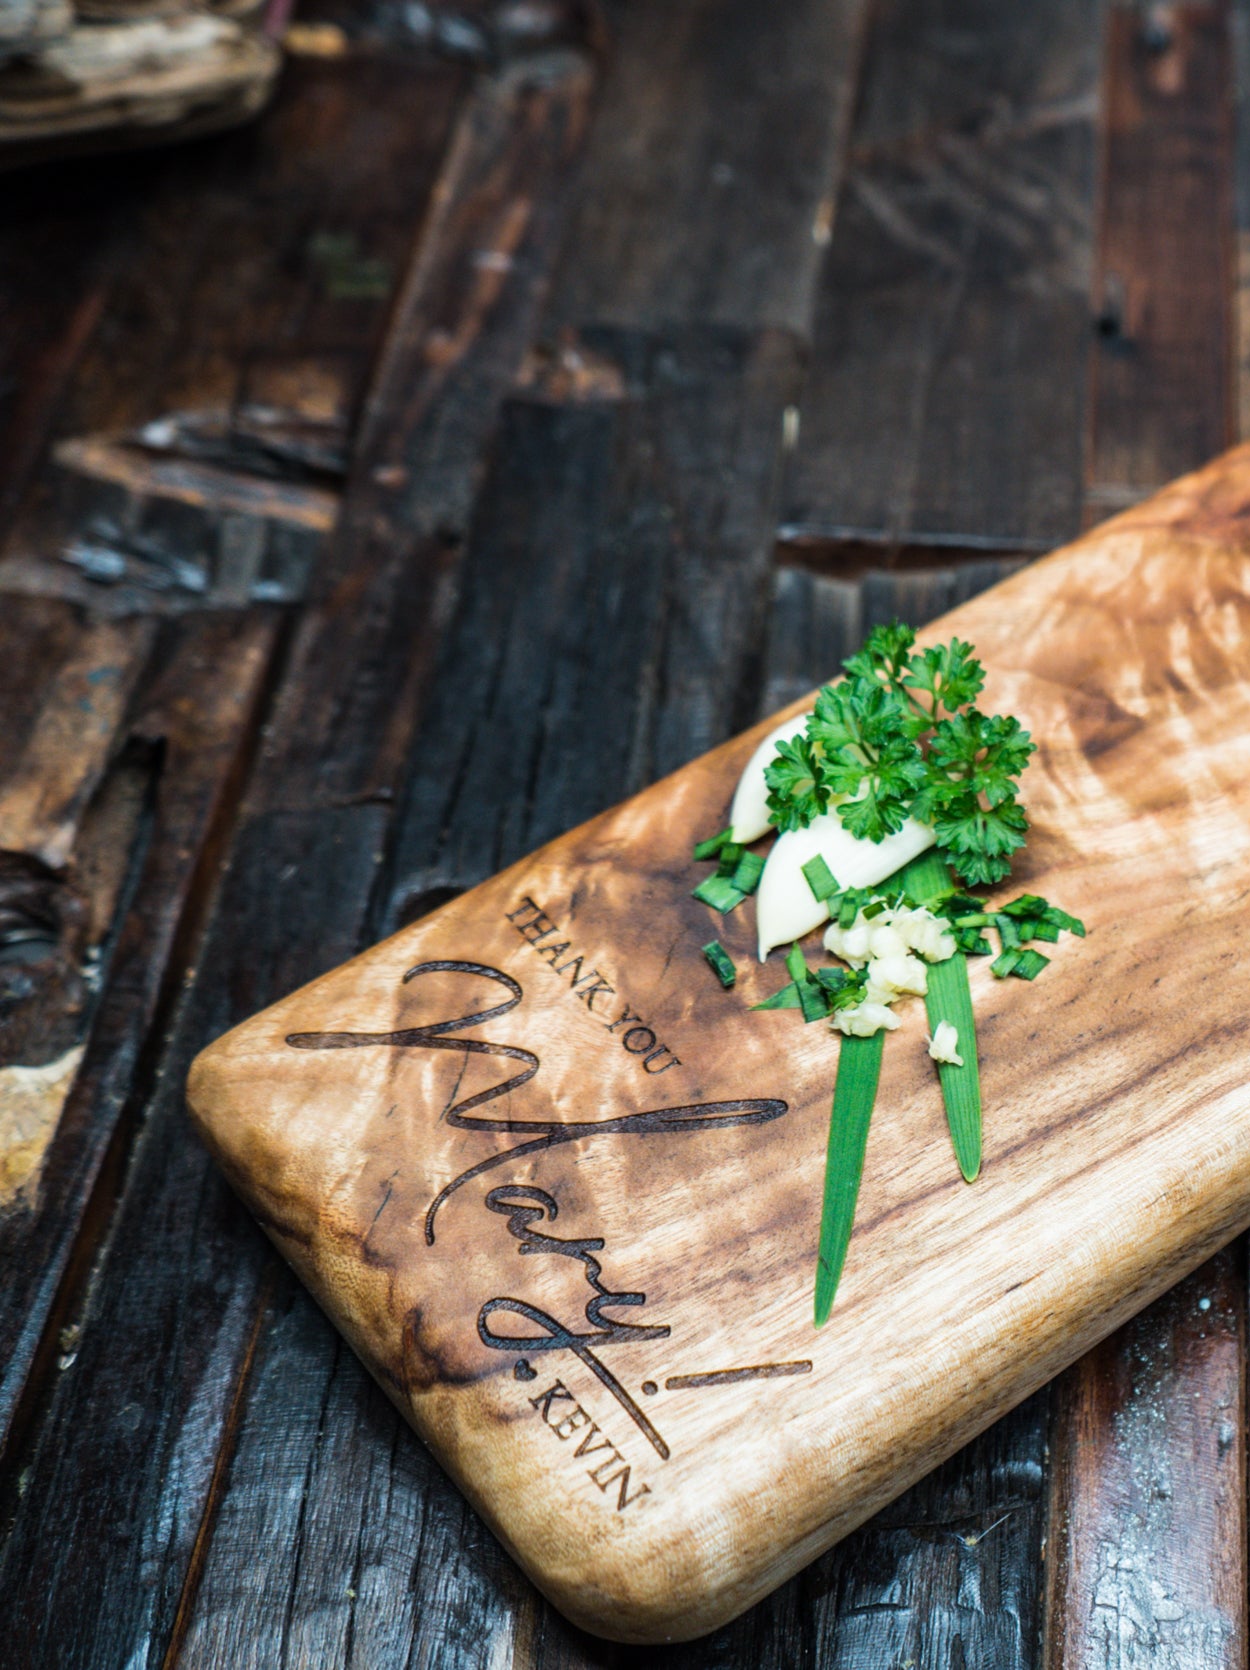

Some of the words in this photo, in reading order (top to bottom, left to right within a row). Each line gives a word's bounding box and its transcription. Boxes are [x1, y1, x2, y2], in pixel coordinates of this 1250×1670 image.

[505, 896, 616, 1011] THANK
[603, 1003, 683, 1075] YOU
[285, 960, 812, 1460] Mary!
[528, 1378, 652, 1511] KEVIN
